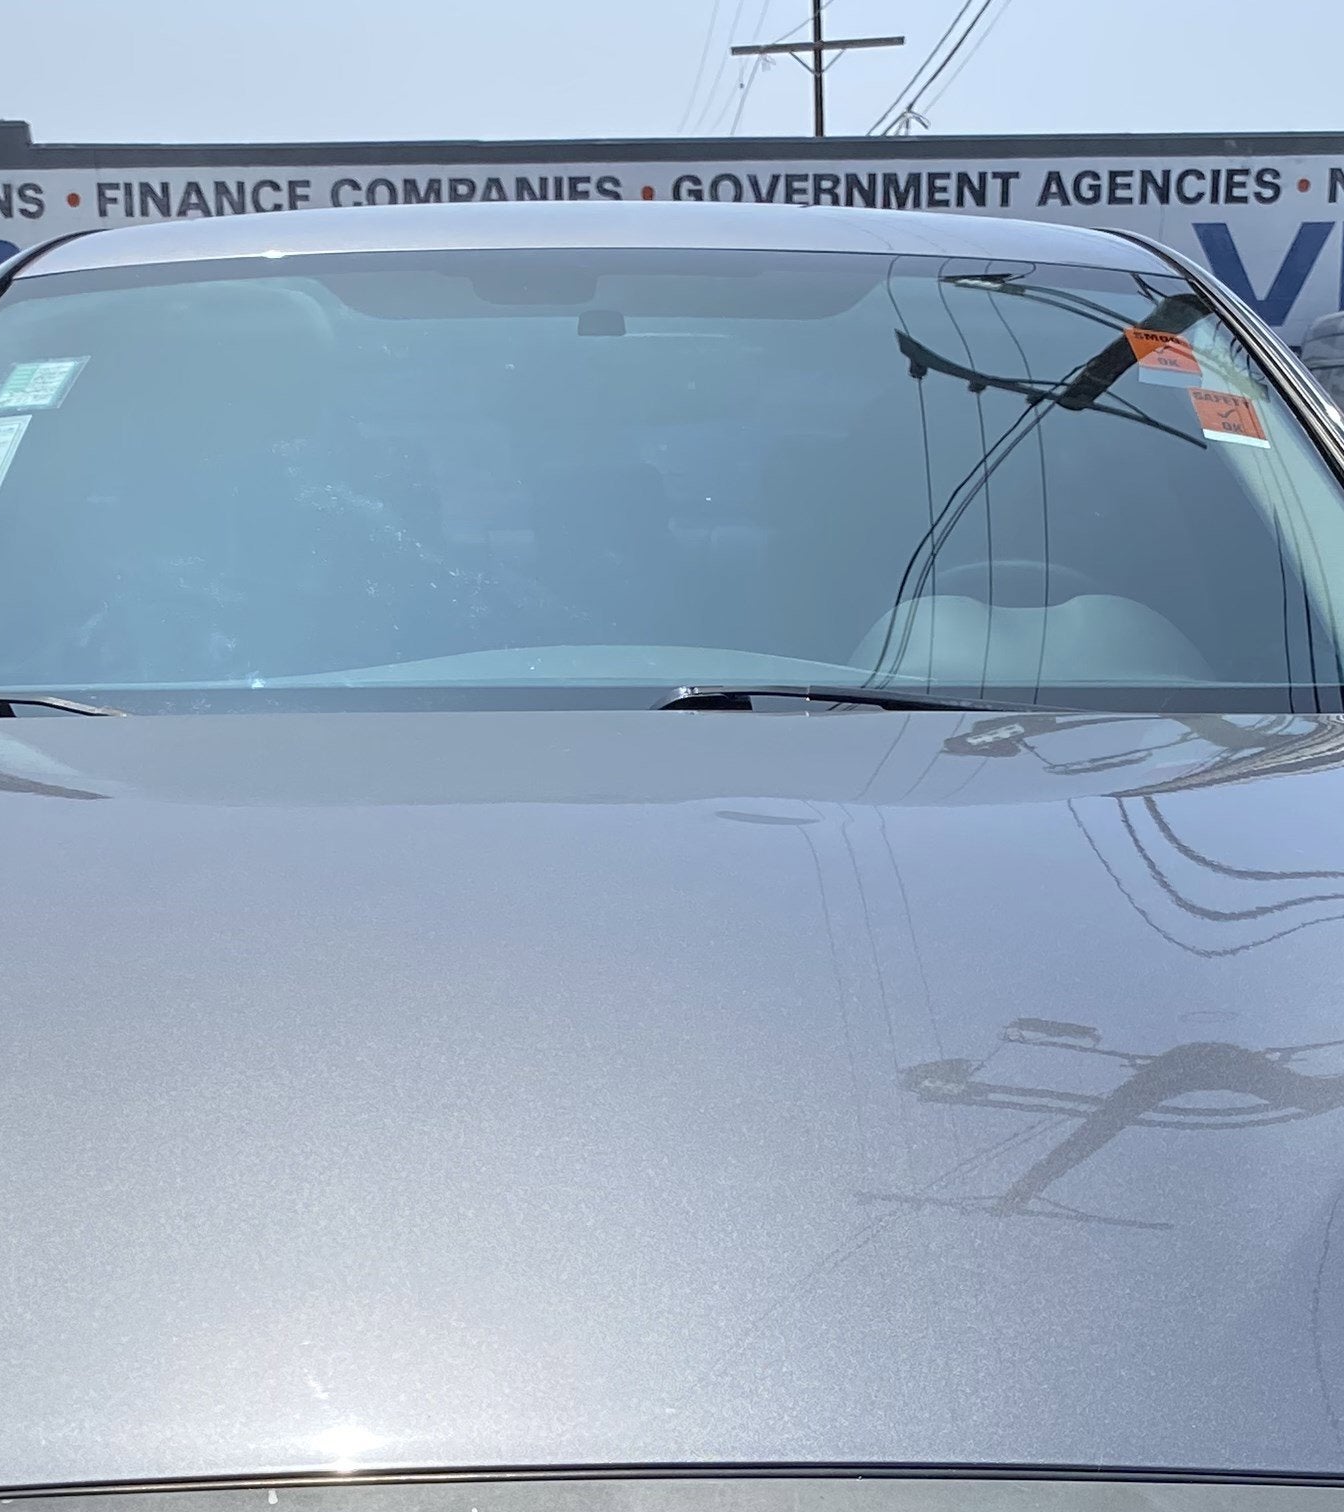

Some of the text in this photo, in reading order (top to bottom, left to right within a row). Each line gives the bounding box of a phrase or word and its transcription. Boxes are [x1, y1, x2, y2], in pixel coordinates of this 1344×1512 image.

[96, 179, 311, 218] FINANCE
[330, 175, 623, 209] COMPANIES
[672, 170, 1020, 209] GOVERNMENT
[1036, 167, 1282, 207] AGENCIES
